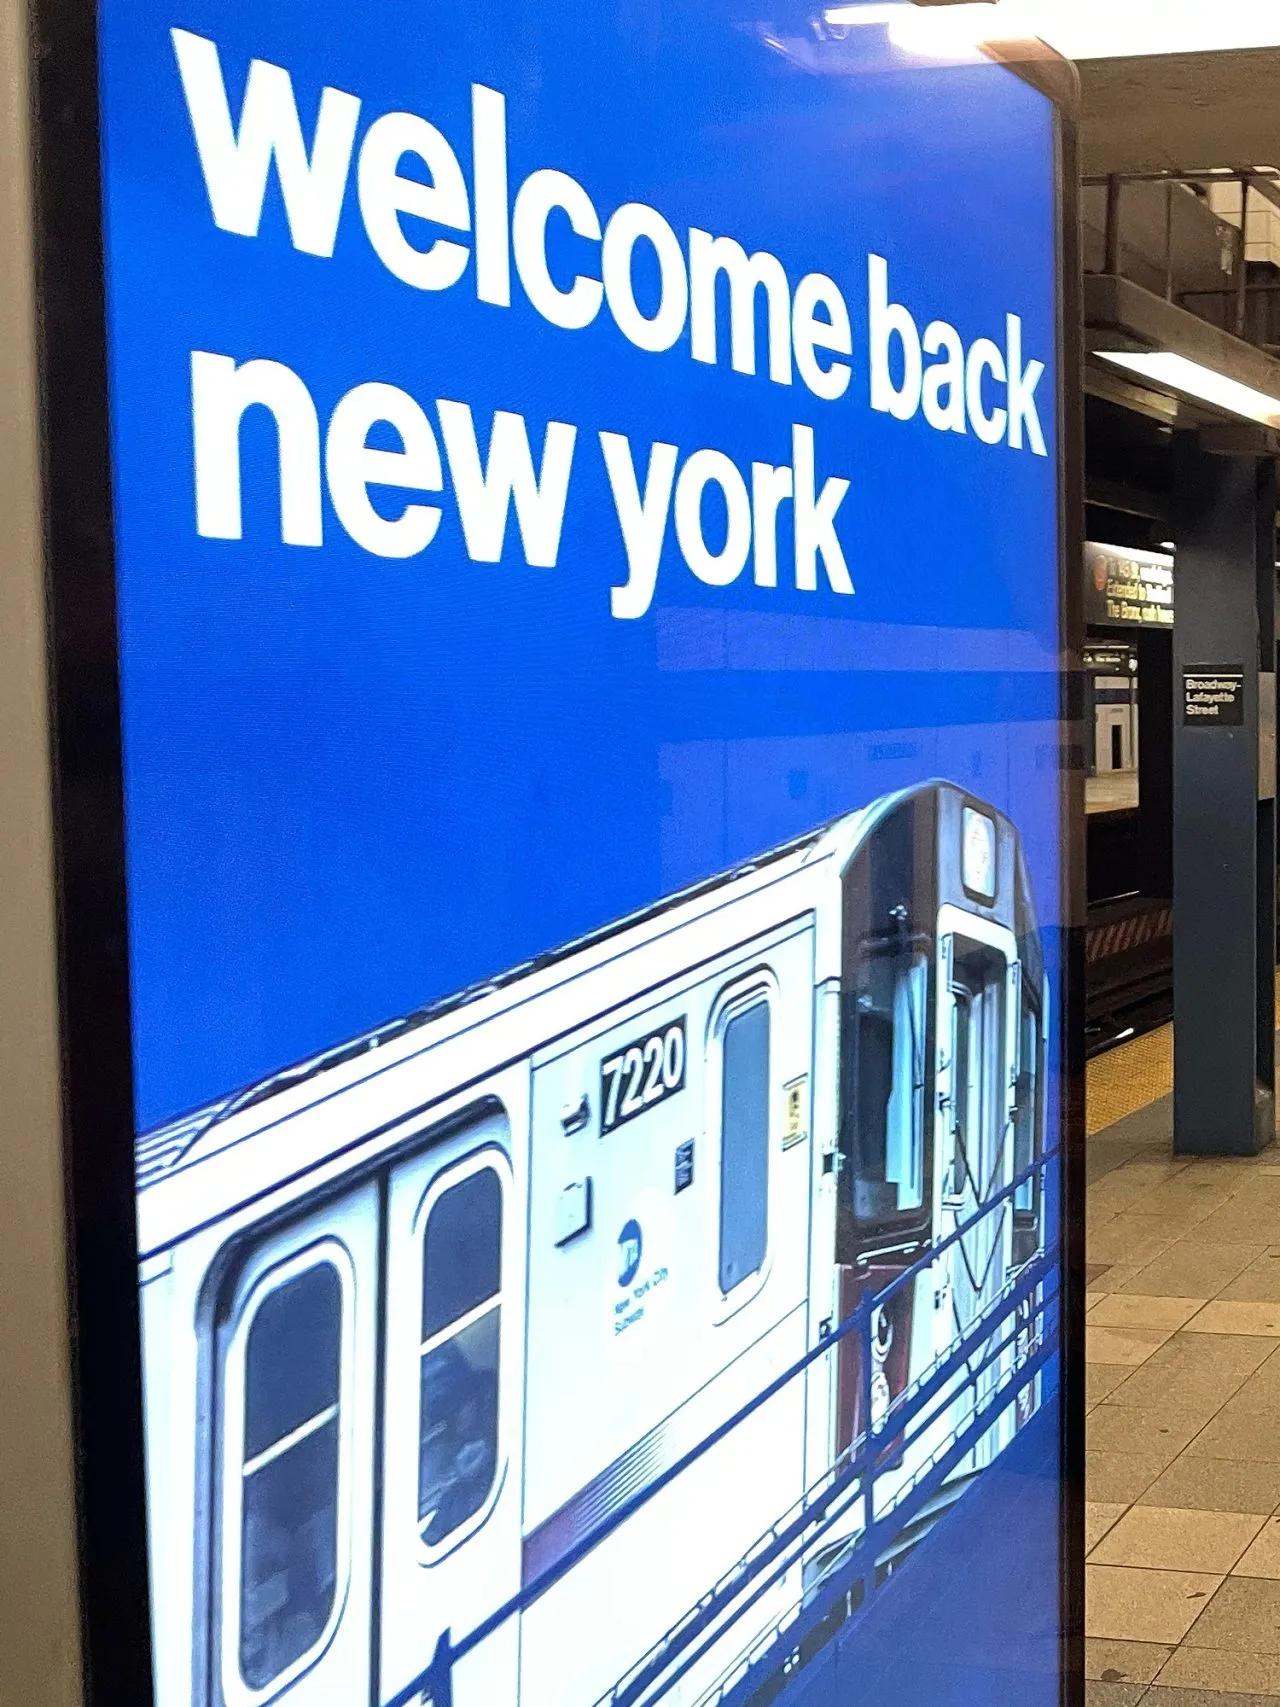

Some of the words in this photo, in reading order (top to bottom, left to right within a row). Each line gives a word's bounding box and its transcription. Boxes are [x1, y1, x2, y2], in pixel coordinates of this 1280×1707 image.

[171, 28, 853, 401] welcome
[868, 253, 1048, 456] back
[191, 350, 577, 568] new
[599, 423, 855, 619] york
[1186, 692, 1235, 704] Lafayette
[1186, 704, 1219, 715] Street
[602, 1026, 684, 1126] 7220
